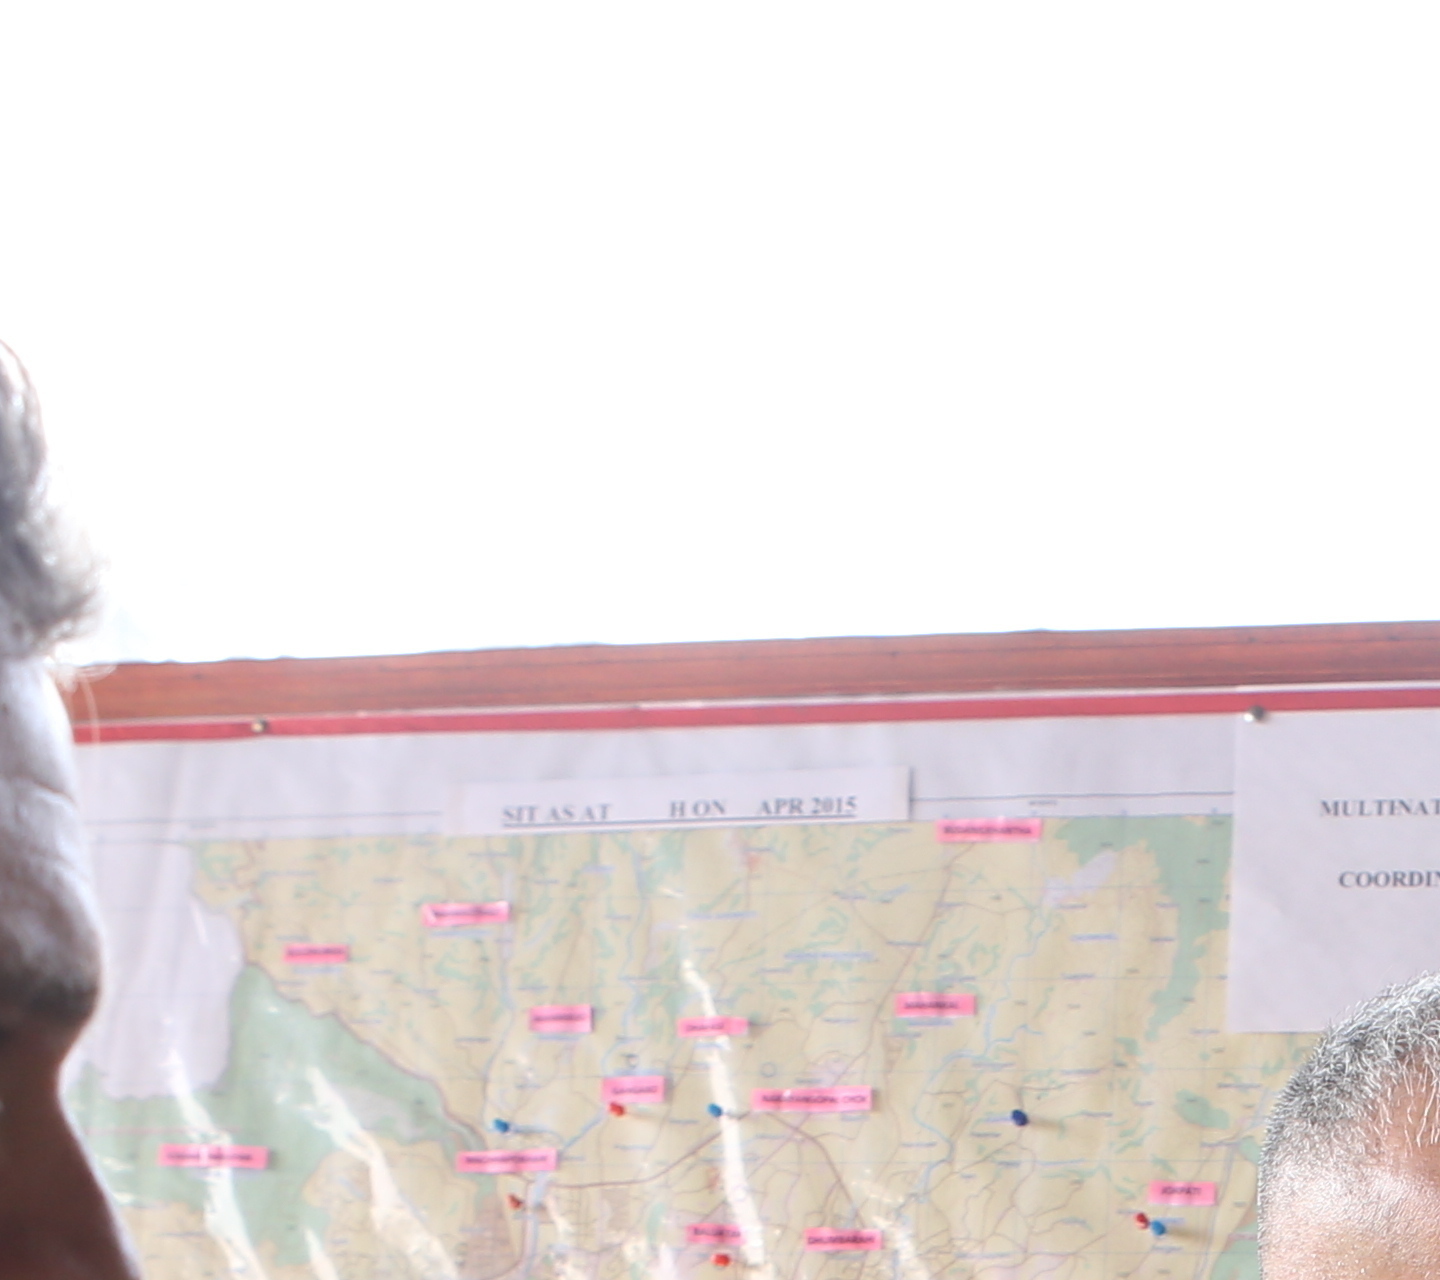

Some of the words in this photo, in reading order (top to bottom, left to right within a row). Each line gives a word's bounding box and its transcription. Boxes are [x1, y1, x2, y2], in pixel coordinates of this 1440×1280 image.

[502, 806, 537, 822] SIT
[549, 805, 574, 822] AS
[585, 804, 611, 821] AT
[670, 800, 685, 818] H
[693, 799, 727, 816] ON
[759, 797, 805, 815] APR
[811, 795, 858, 814] 2015
